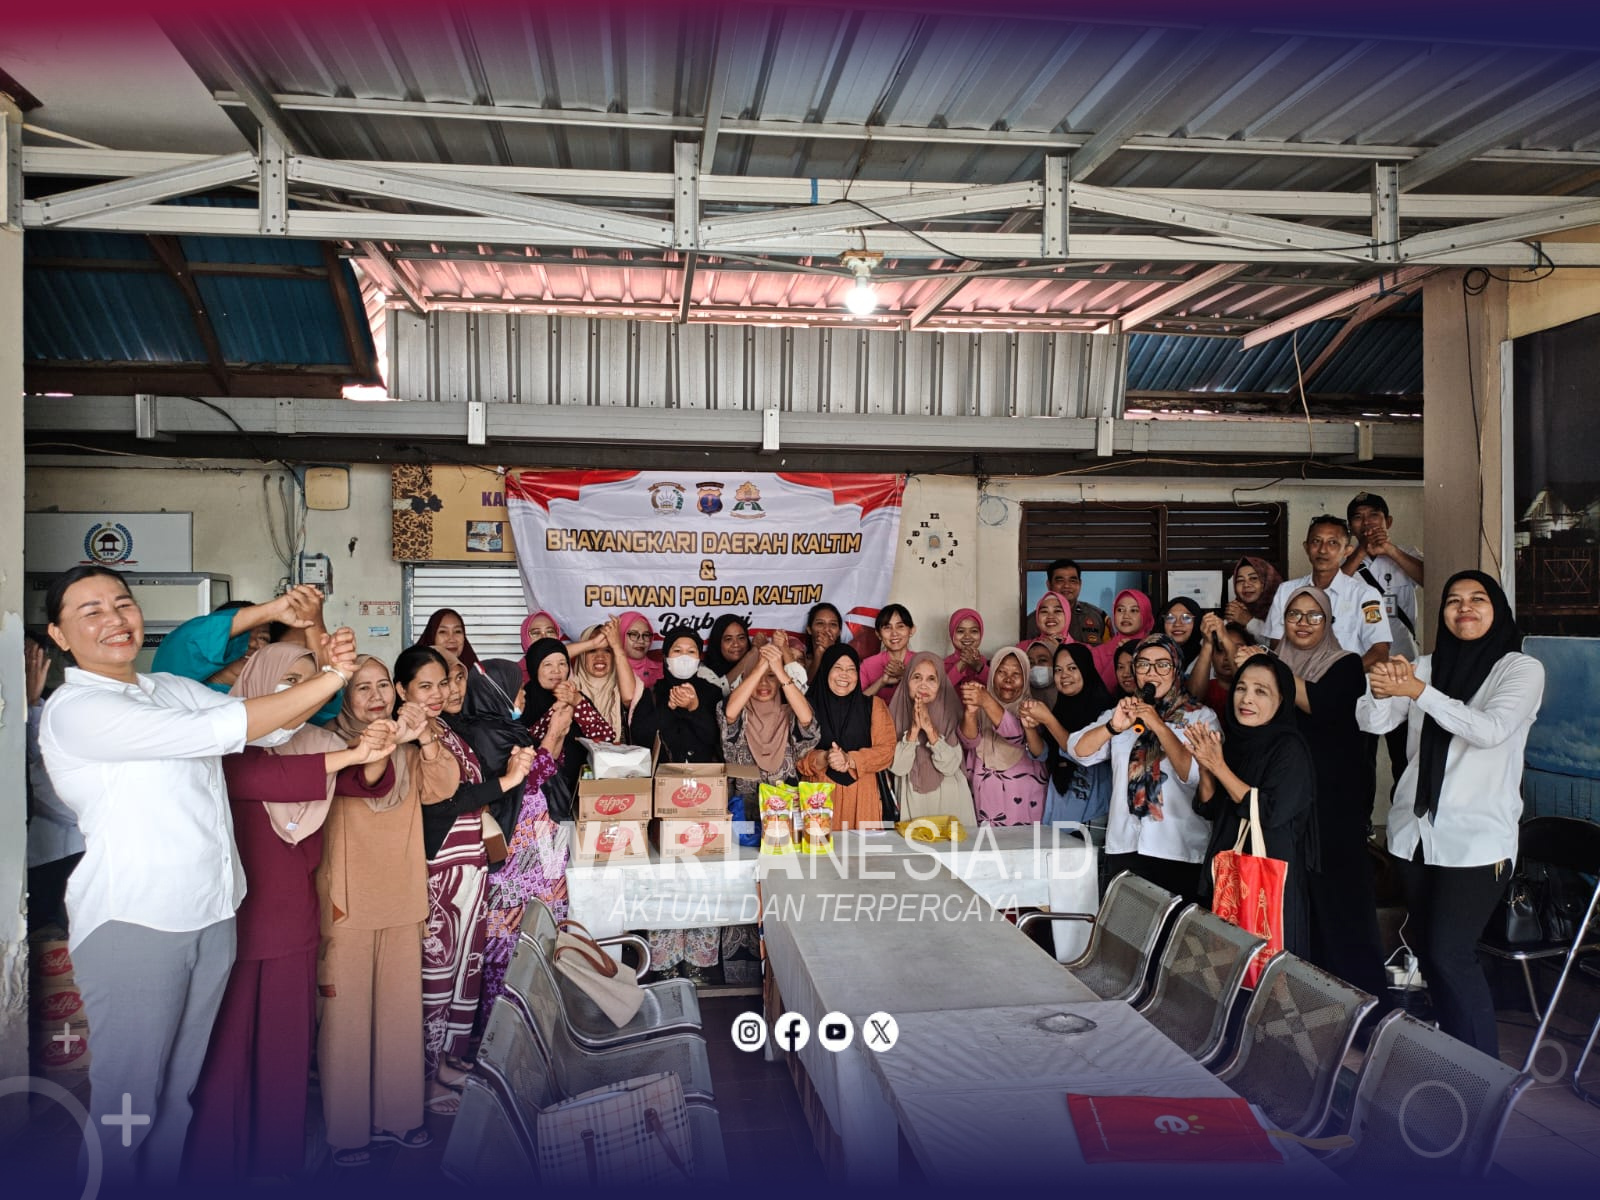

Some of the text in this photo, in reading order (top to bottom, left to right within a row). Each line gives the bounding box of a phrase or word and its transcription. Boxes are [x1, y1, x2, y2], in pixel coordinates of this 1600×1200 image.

[545, 528, 863, 555] BHAYANGKARI DAERAH KALTIM
[952, 539, 959, 547] 3
[699, 559, 718, 581] &
[919, 556, 925, 565] 7
[585, 584, 823, 608] POLWAN POLDA KALTIM
